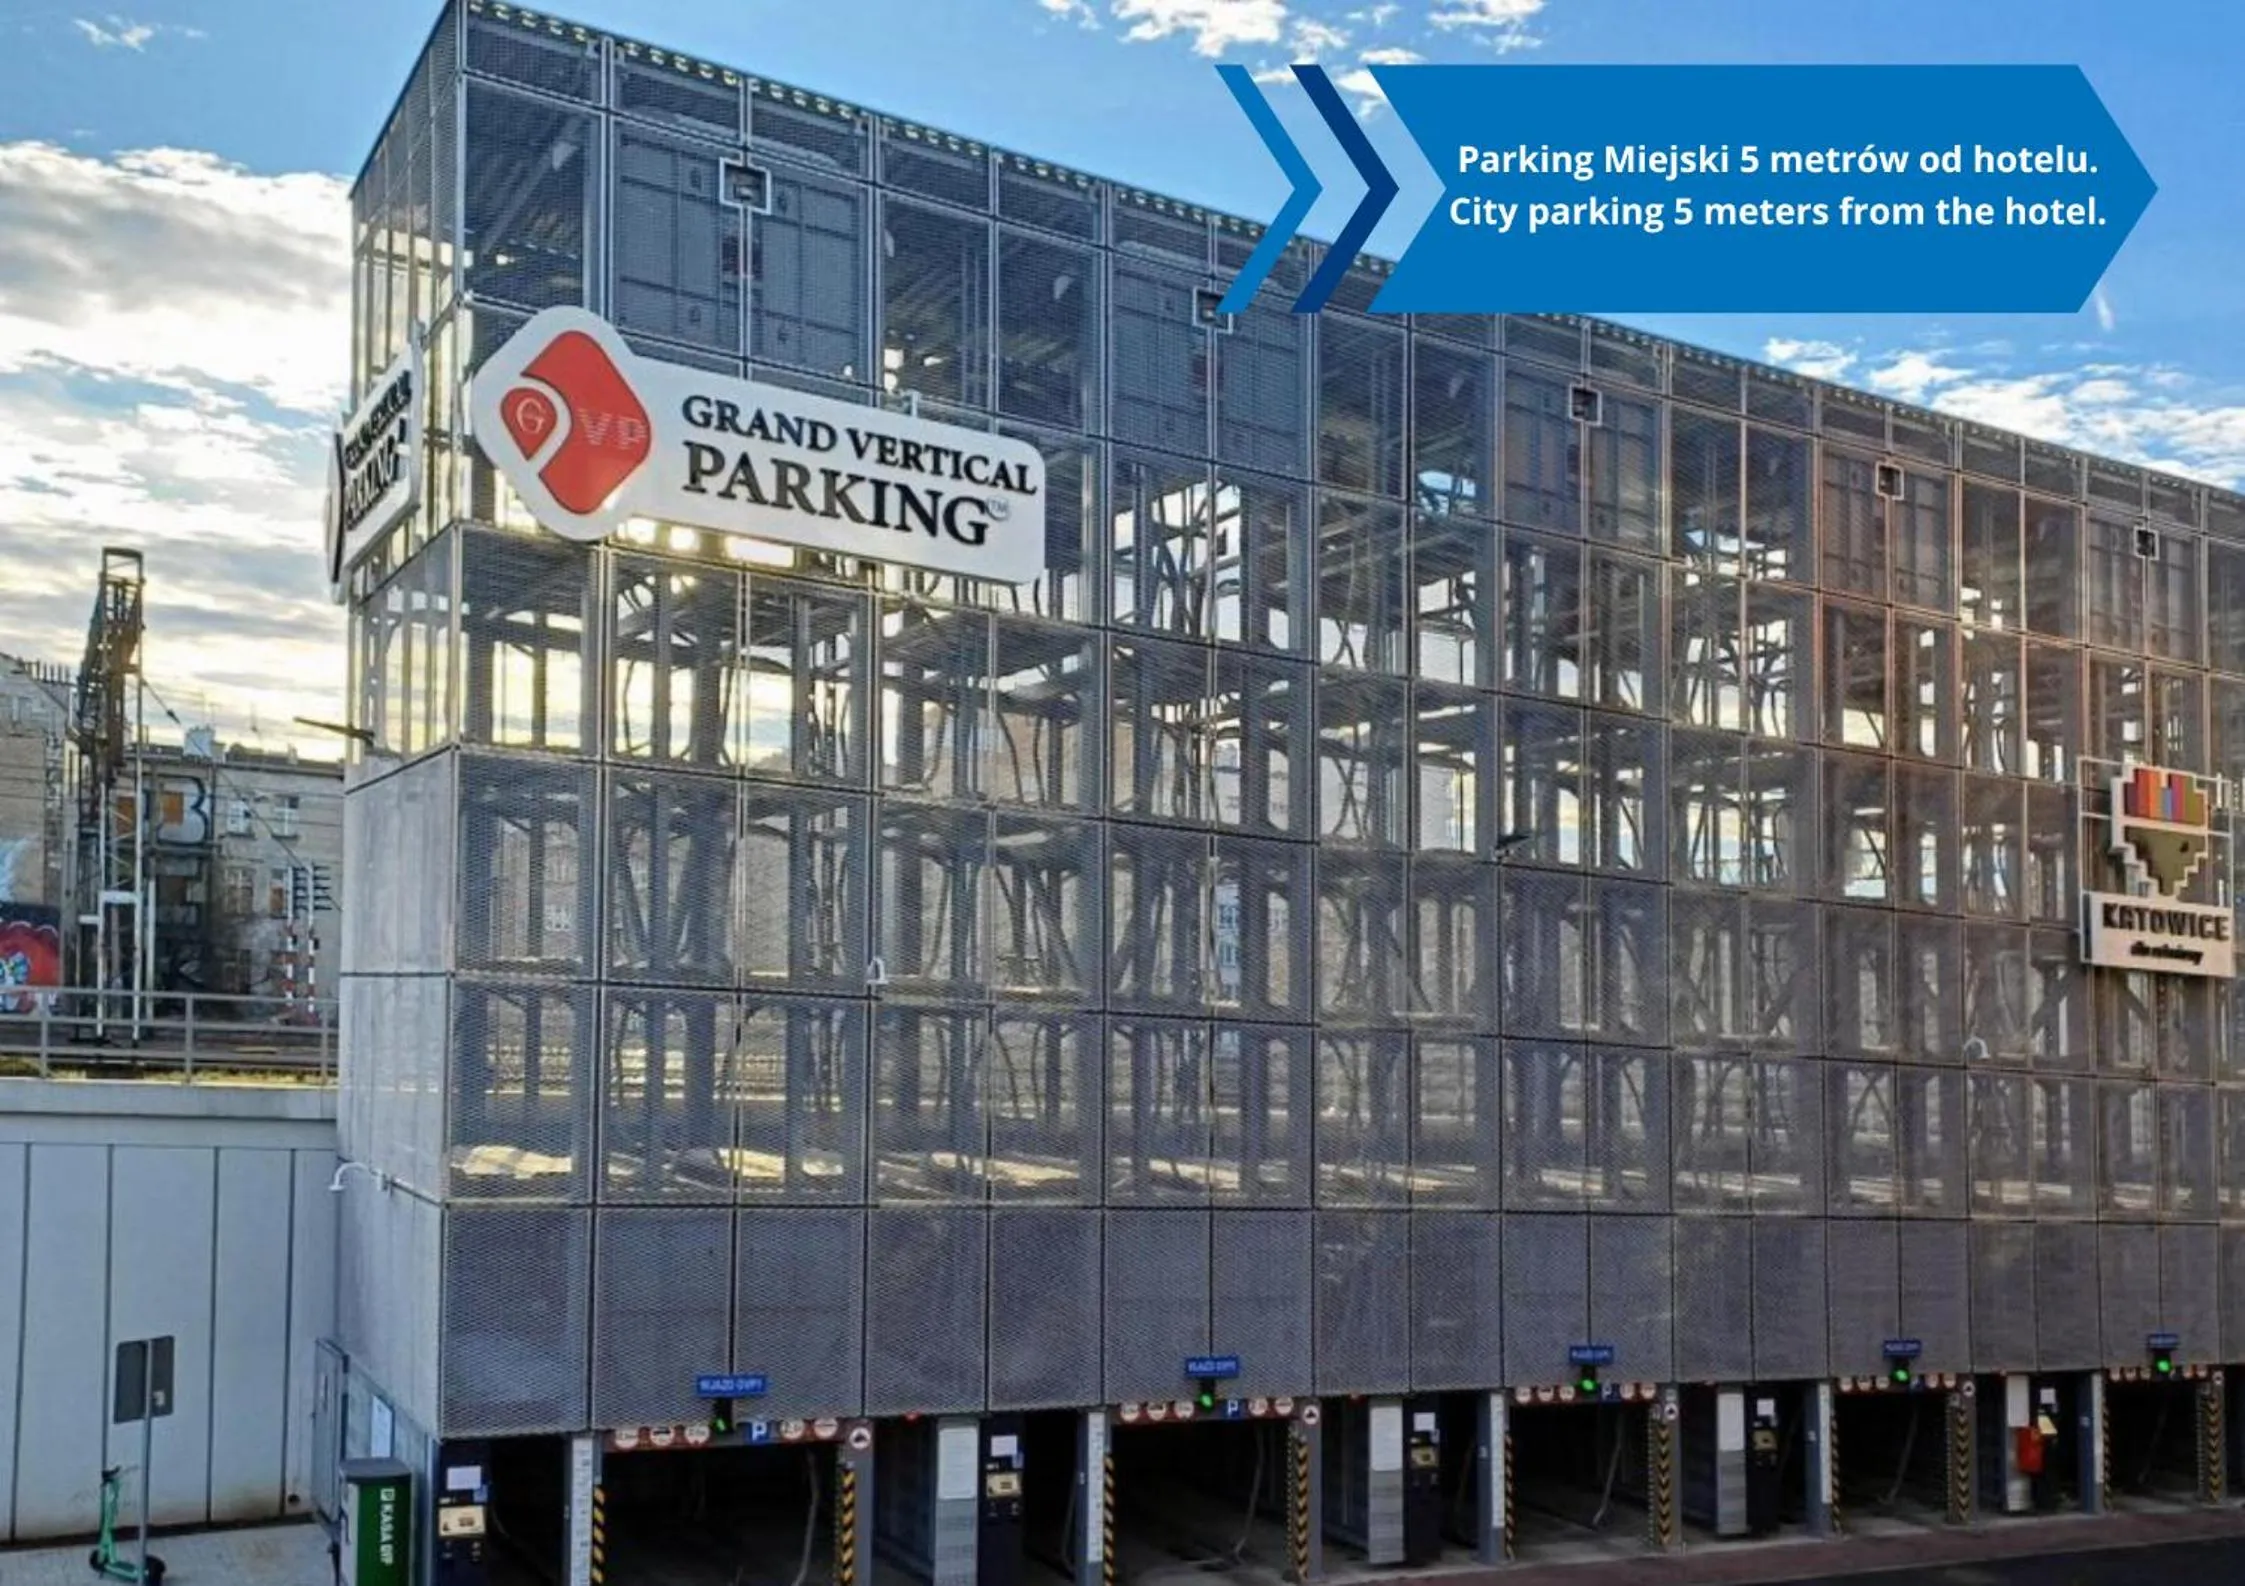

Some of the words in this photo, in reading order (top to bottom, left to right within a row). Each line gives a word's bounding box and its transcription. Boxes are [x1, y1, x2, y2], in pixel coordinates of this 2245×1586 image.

[515, 397, 546, 435] G
[681, 394, 838, 452] GRAND
[845, 427, 1038, 496] VERTICAL
[682, 440, 990, 547] PARKING
[2102, 902, 2230, 941] KATOWICE
[752, 1421, 767, 1441] P
